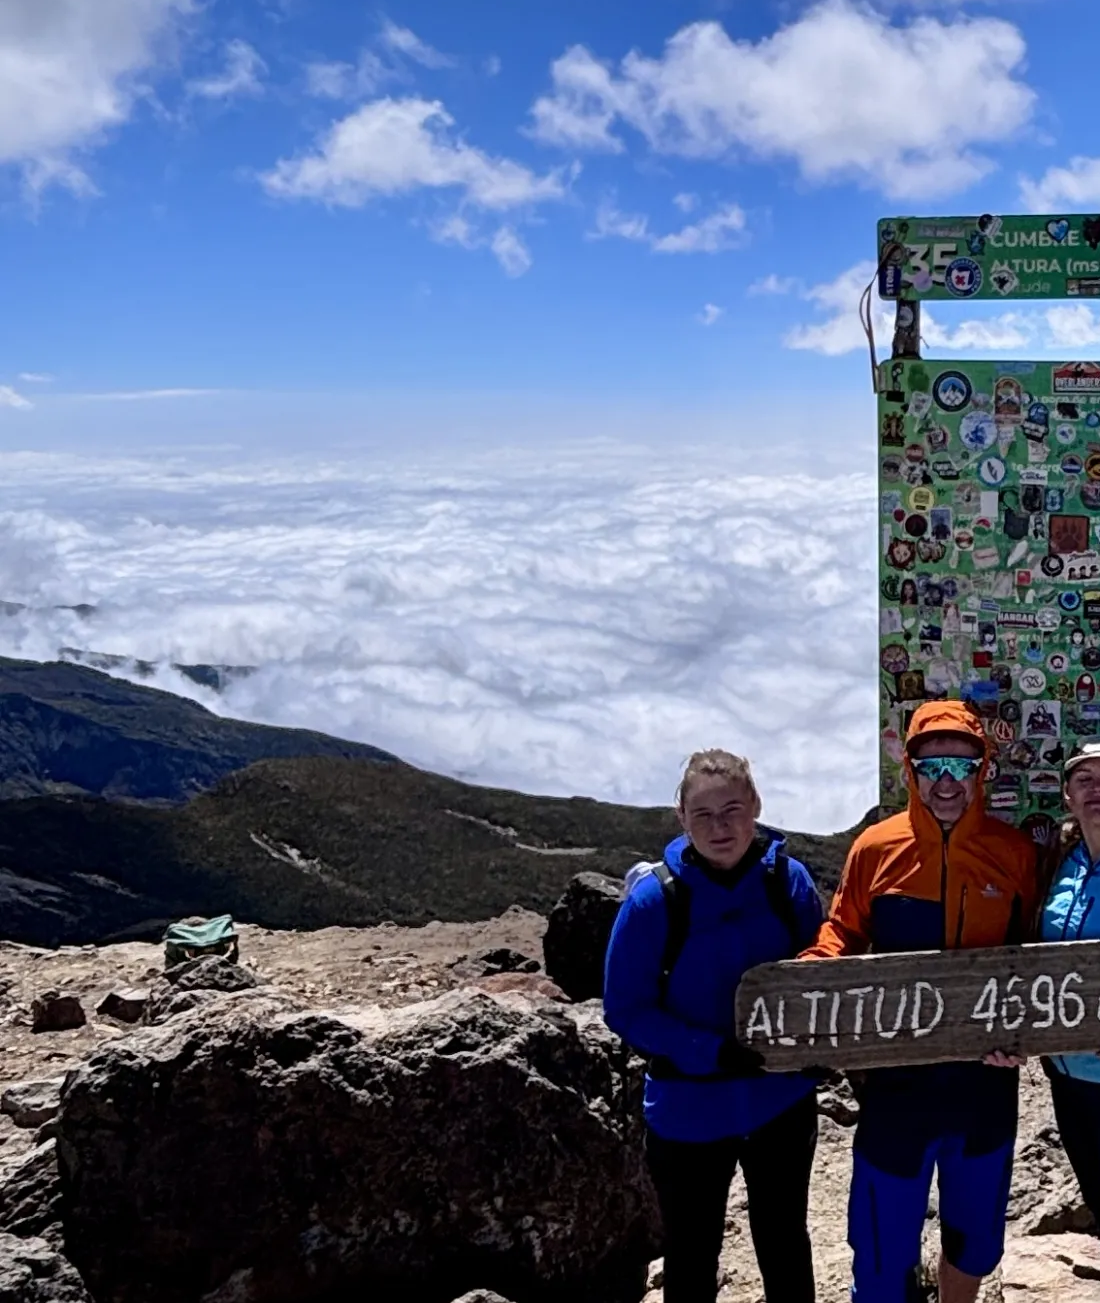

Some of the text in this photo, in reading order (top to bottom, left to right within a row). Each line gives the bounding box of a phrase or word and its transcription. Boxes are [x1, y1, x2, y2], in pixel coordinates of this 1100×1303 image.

[990, 230, 1080, 247] CUMBE
[746, 981, 945, 1048] ALTITUD
[970, 972, 1086, 1032] 4696
